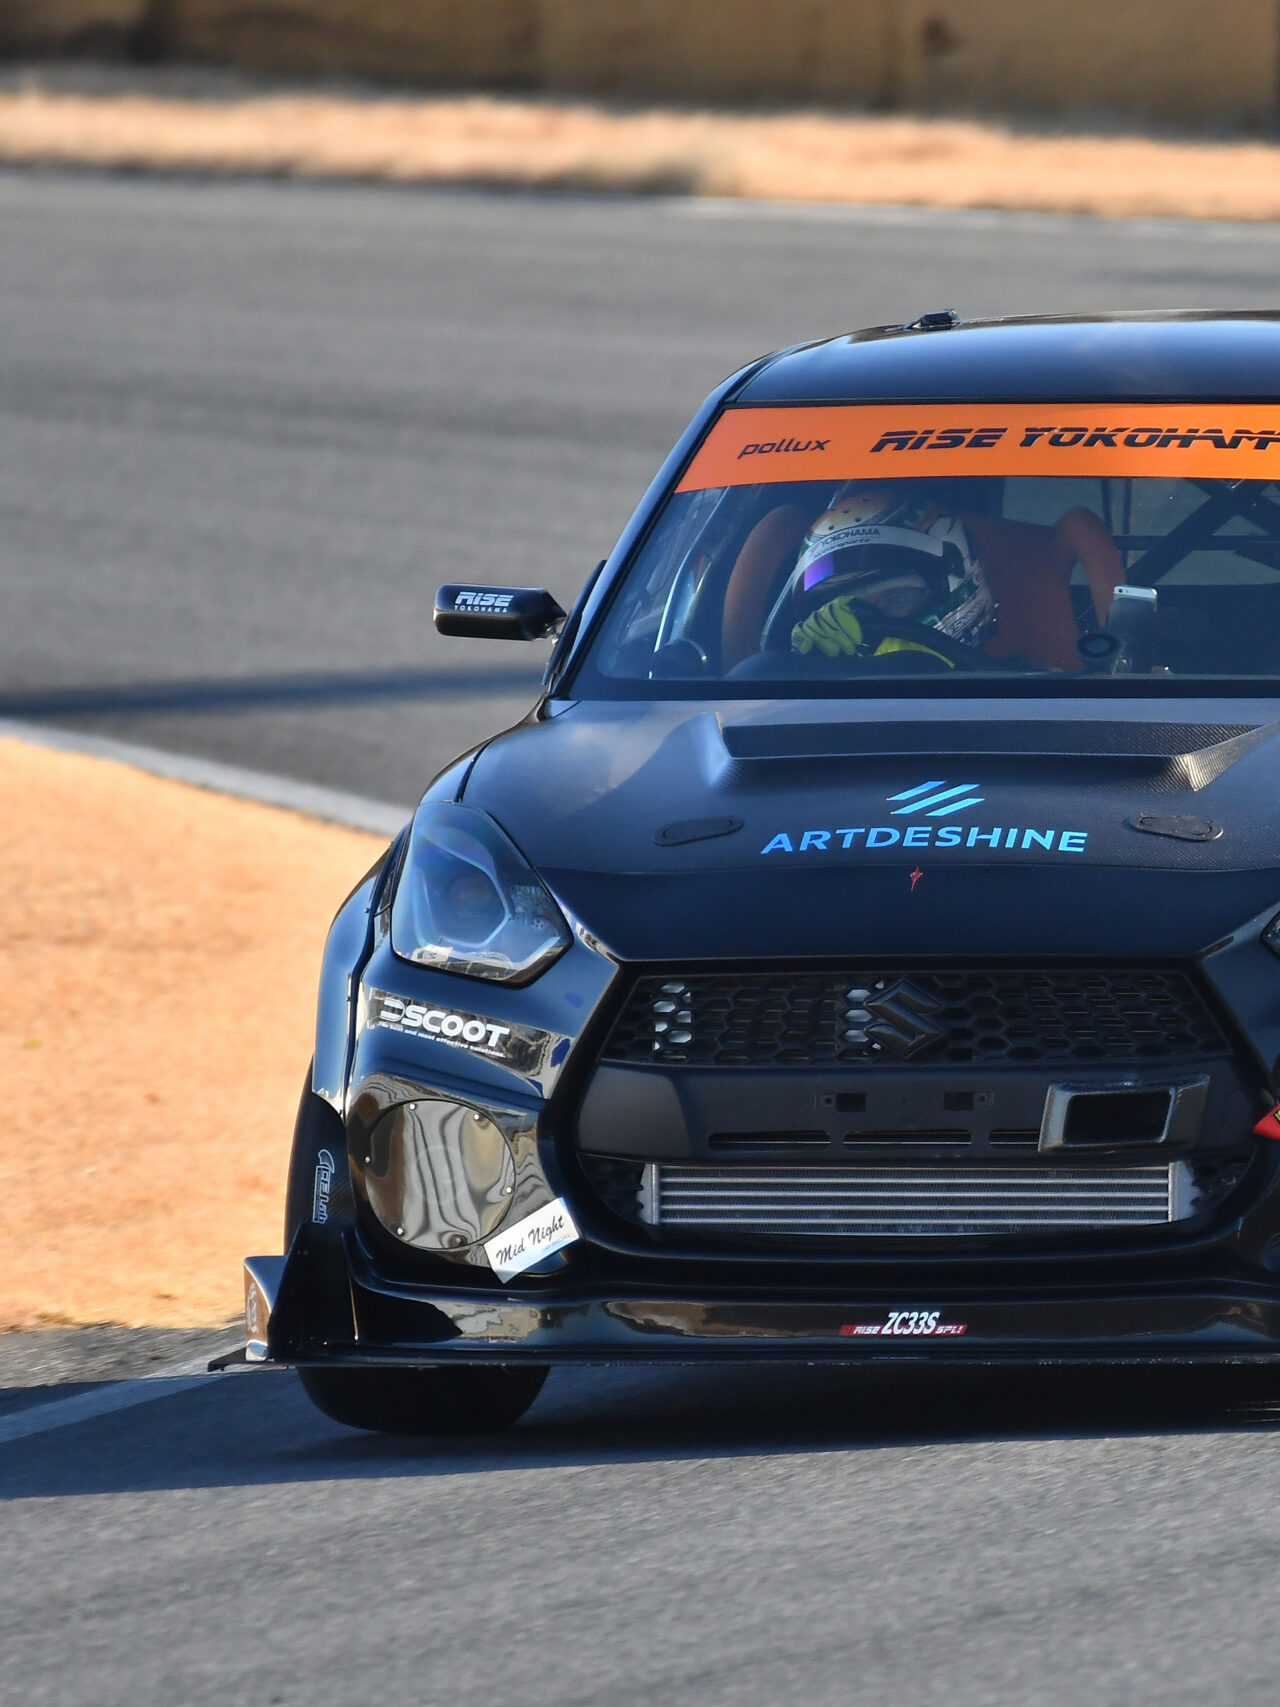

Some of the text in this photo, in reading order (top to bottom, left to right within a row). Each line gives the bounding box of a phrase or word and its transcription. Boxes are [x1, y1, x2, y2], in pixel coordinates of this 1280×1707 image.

[737, 438, 831, 460] pollux
[869, 427, 1009, 453] RISE
[454, 591, 514, 607] RISE
[454, 604, 507, 613] YOKOHAMA
[760, 826, 1089, 855] ARTDESHINE
[495, 1236, 526, 1266] Mid
[527, 1214, 564, 1246] Night
[853, 1325, 881, 1335] RISE
[881, 1311, 940, 1336] ZC33S
